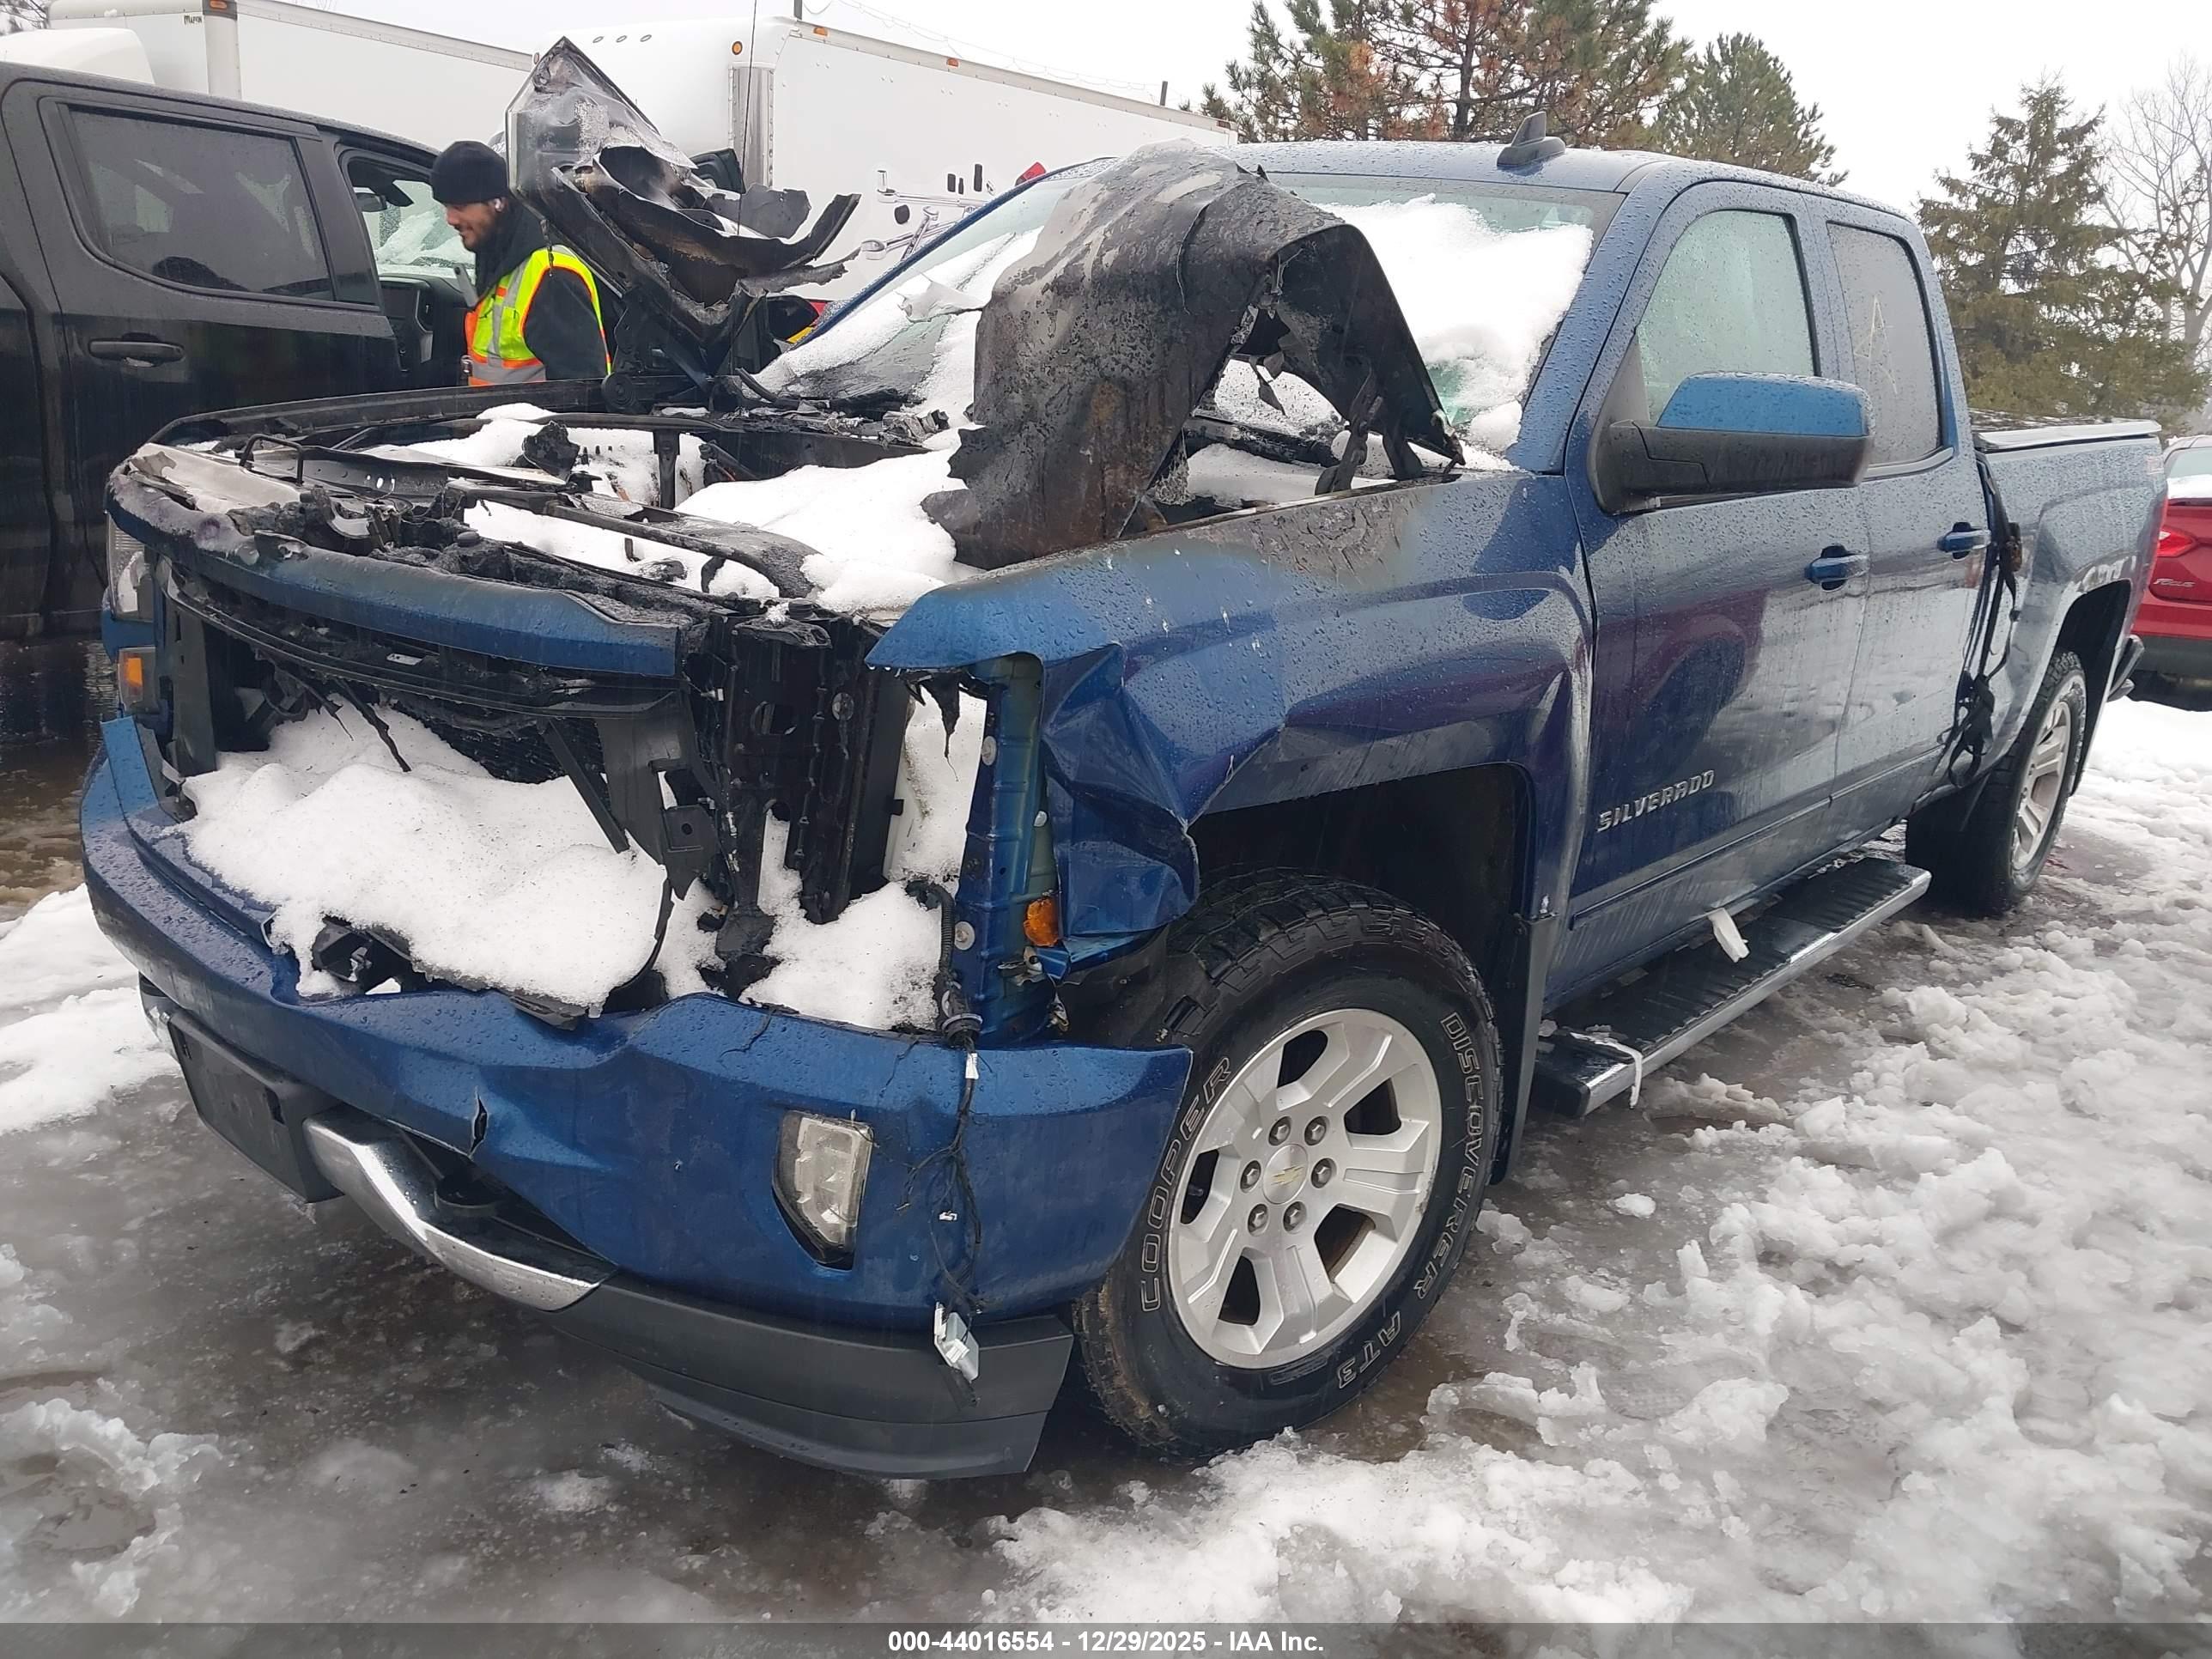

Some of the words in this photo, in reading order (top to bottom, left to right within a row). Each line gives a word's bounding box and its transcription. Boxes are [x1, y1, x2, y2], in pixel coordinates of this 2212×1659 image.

[1595, 769, 1715, 833] SILVERADO
[1141, 1057, 1231, 1312] COOPER
[1413, 1012, 1484, 1300] DISCOVERER
[1337, 1310, 1402, 1389] AT3
